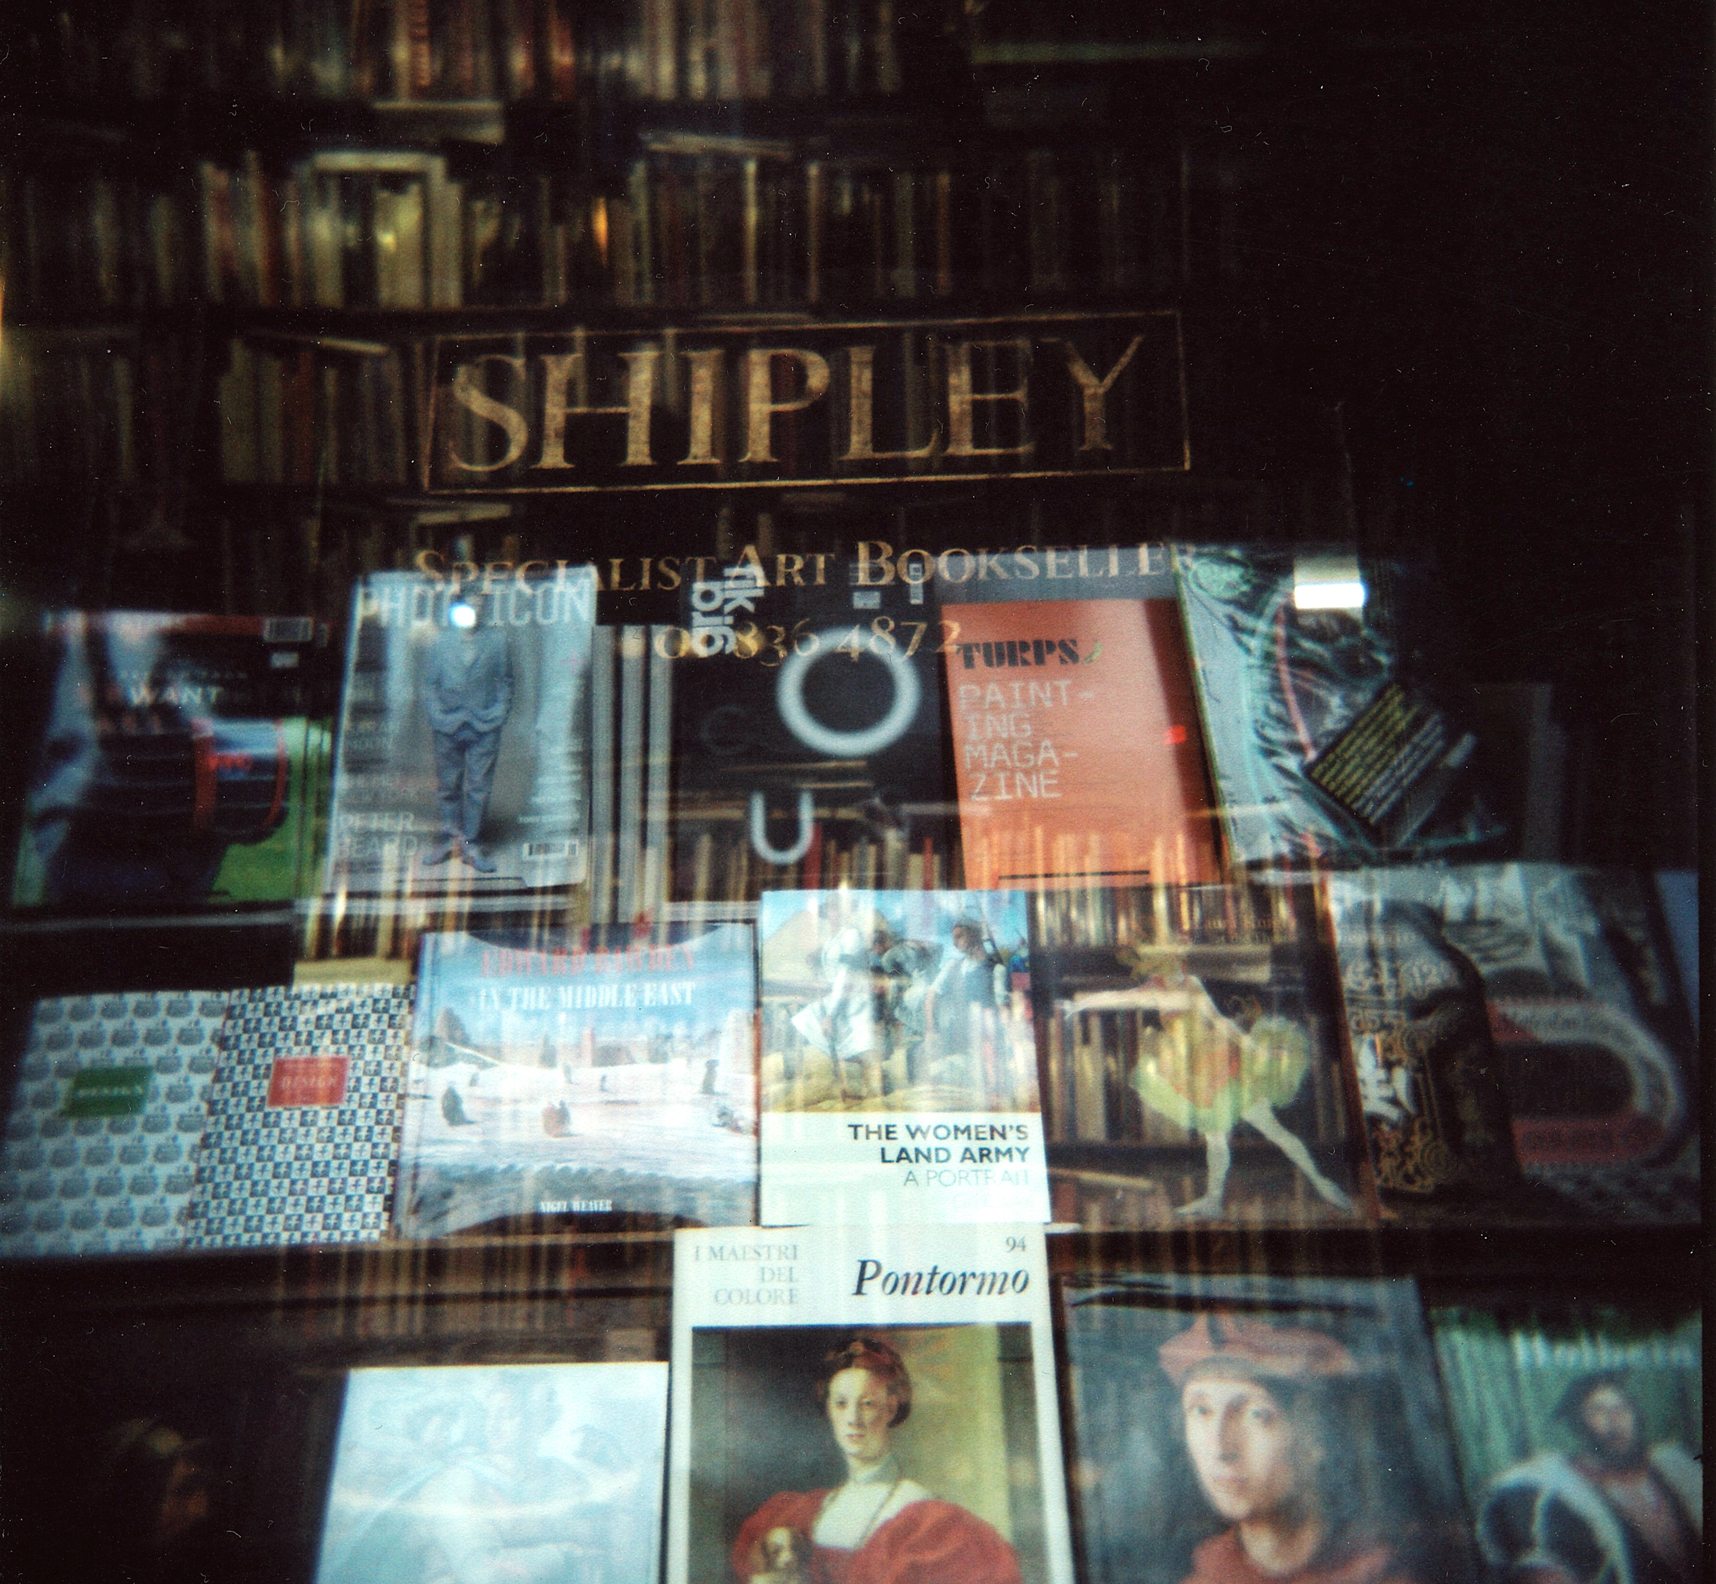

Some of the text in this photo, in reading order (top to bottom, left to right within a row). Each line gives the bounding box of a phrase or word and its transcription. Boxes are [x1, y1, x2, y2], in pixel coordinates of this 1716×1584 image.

[449, 335, 1143, 472] SHIPLEY
[415, 550, 717, 595] SPECIALIST
[736, 543, 835, 587] ART
[361, 579, 592, 627] PHOTICON
[956, 639, 1079, 670] TURPS
[957, 680, 1095, 712] PAINT-
[965, 712, 1032, 740] ING
[965, 739, 1079, 771] MAGA-
[970, 771, 1063, 801] ZINE
[508, 986, 551, 1010] THE
[557, 983, 637, 1009] MIDDLE
[644, 981, 696, 1005] EAST
[847, 1123, 1029, 1141] THE WOMEN'S
[880, 1146, 1031, 1164] LAND ARMY
[903, 1169, 920, 1187] A
[1005, 1236, 1026, 1253] 94
[760, 1266, 799, 1284] DEL
[852, 1259, 1030, 1297] Pontormo
[713, 1287, 799, 1305] COLORE
